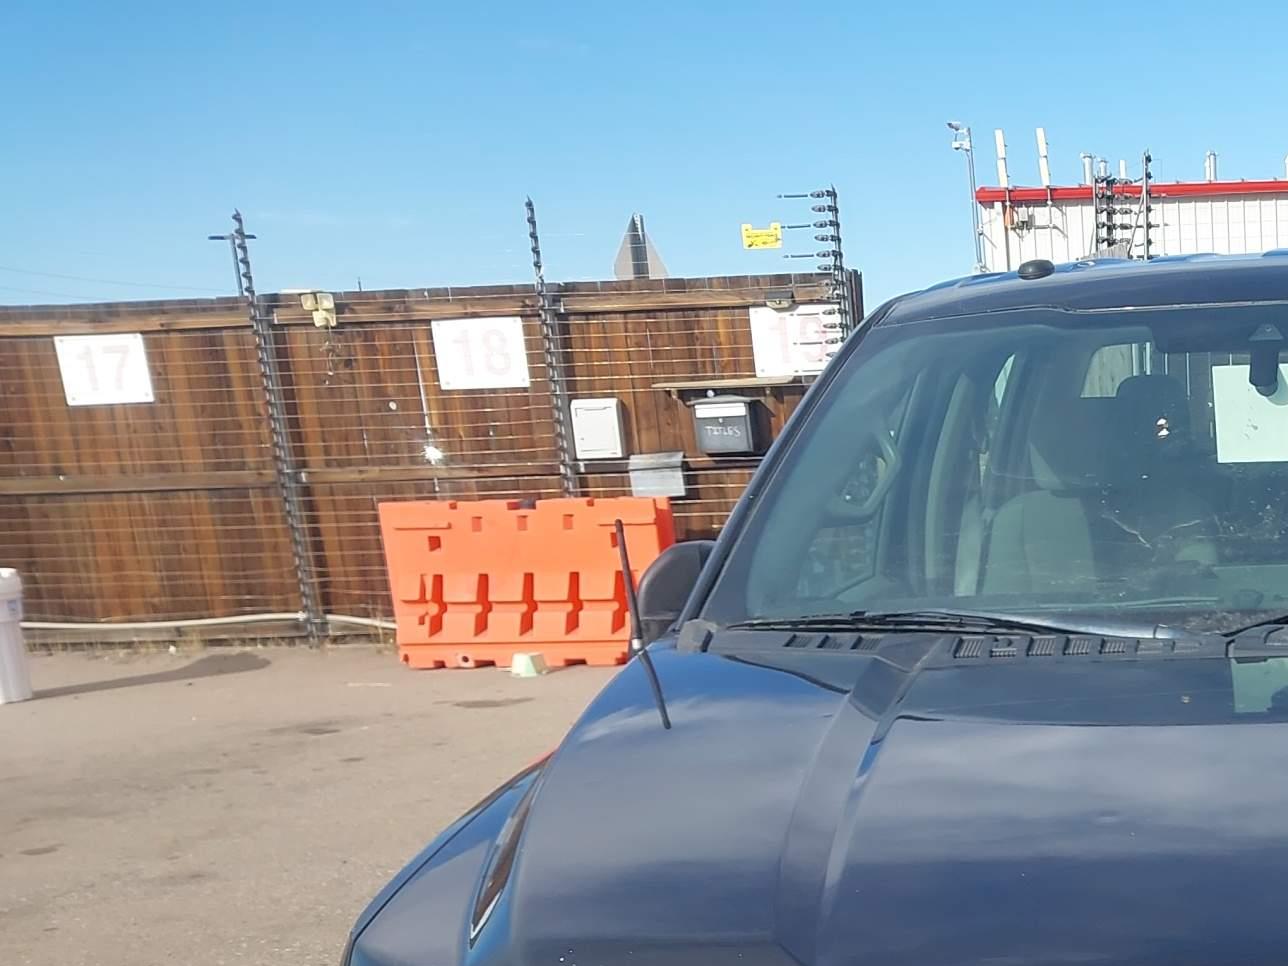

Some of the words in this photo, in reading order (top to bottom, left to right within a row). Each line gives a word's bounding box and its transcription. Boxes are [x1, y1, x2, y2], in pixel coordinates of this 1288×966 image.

[77, 344, 129, 391] 17
[453, 329, 511, 376] 18
[704, 425, 742, 438] TITLES
